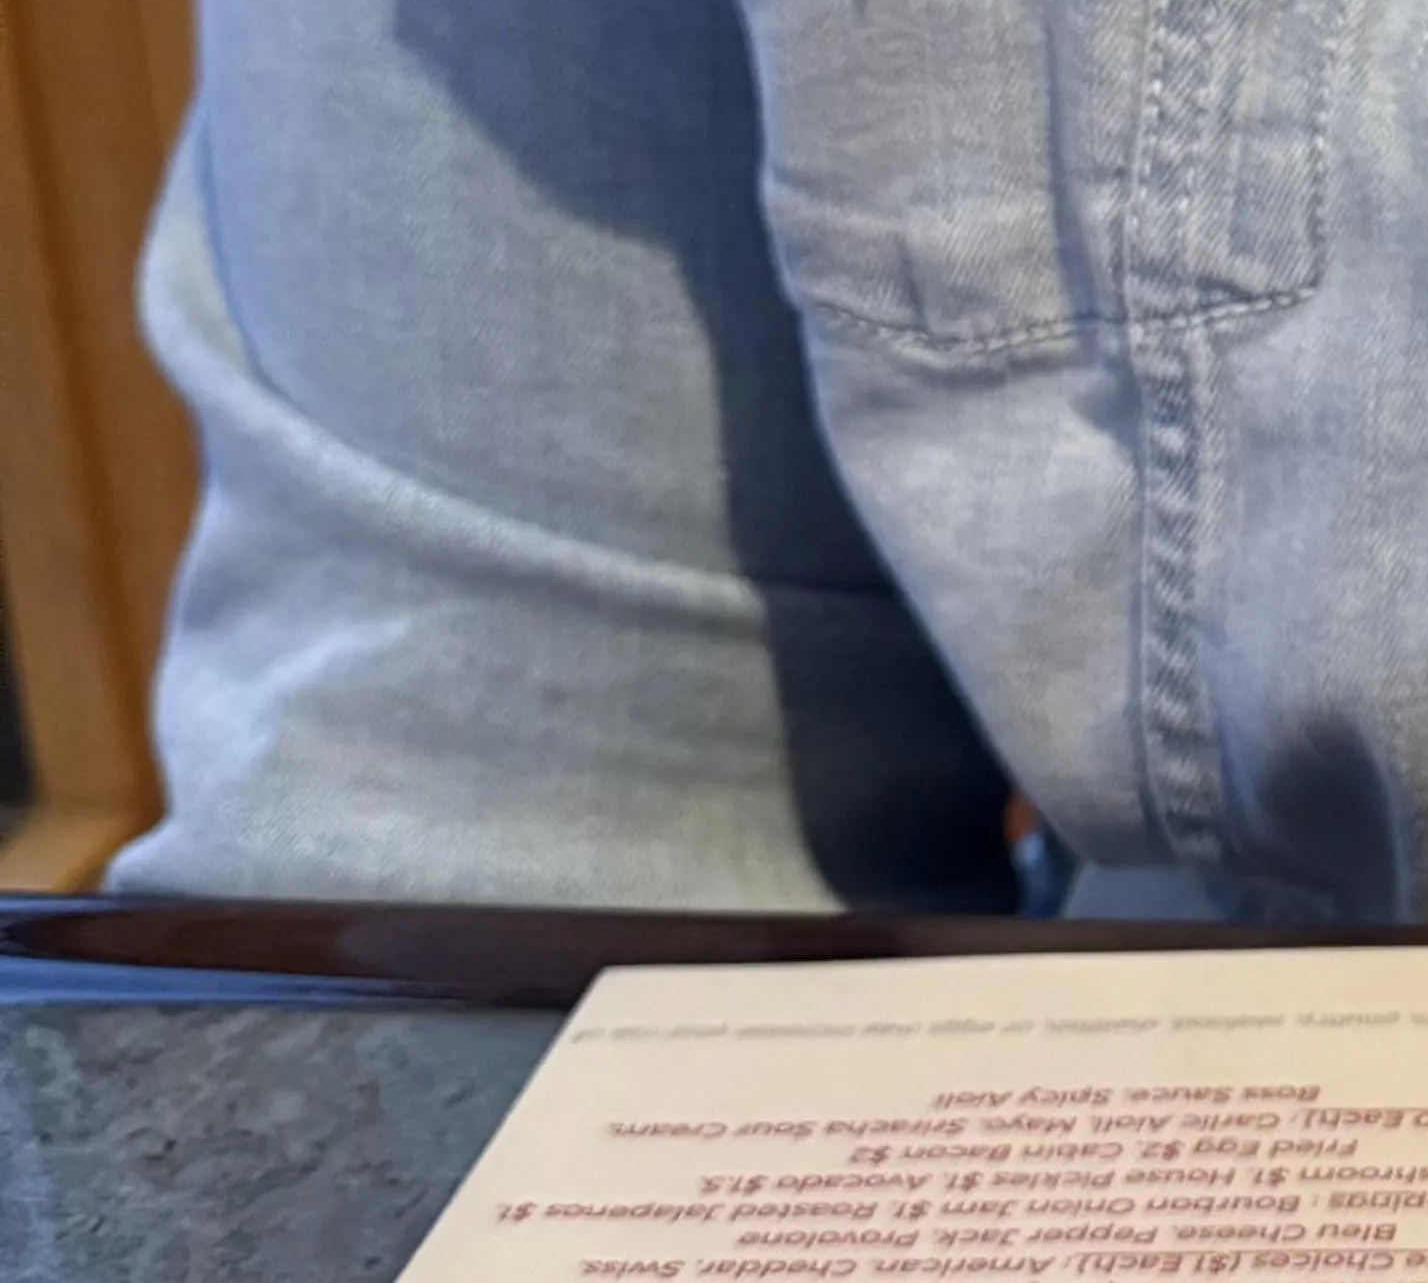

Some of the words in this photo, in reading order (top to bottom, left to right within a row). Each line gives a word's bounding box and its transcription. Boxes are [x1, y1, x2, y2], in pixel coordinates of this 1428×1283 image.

[932, 1091, 1013, 1109] Aioli
[1019, 1085, 1114, 1108] Spicy
[1243, 1085, 1321, 1104] Boss
[733, 1121, 815, 1140] Sour
[825, 1118, 967, 1138] Sriracha
[1180, 1113, 1281, 1131] Garlic
[901, 1144, 1012, 1163] Bacon
[1022, 1142, 1125, 1161] Cabin
[1192, 1137, 1262, 1159] Egg
[1268, 1138, 1359, 1158] Fried
[776, 1173, 932, 1192] Avocado
[991, 1171, 1115, 1190] Pickles
[1125, 1167, 1236, 1187] House
[732, 1201, 879, 1221] Roasted
[941, 1199, 1019, 1218] Jam
[1026, 1197, 1136, 1216] Onion
[1146, 1194, 1302, 1213] Bourbon
[736, 1229, 920, 1249] Provolone
[1027, 1224, 1160, 1246] Pepper
[1170, 1225, 1307, 1242] Cheese,
[1318, 1224, 1397, 1242] Bleu
[697, 1258, 858, 1278] Cheddar,
[1253, 1249, 1396, 1274] Choices
